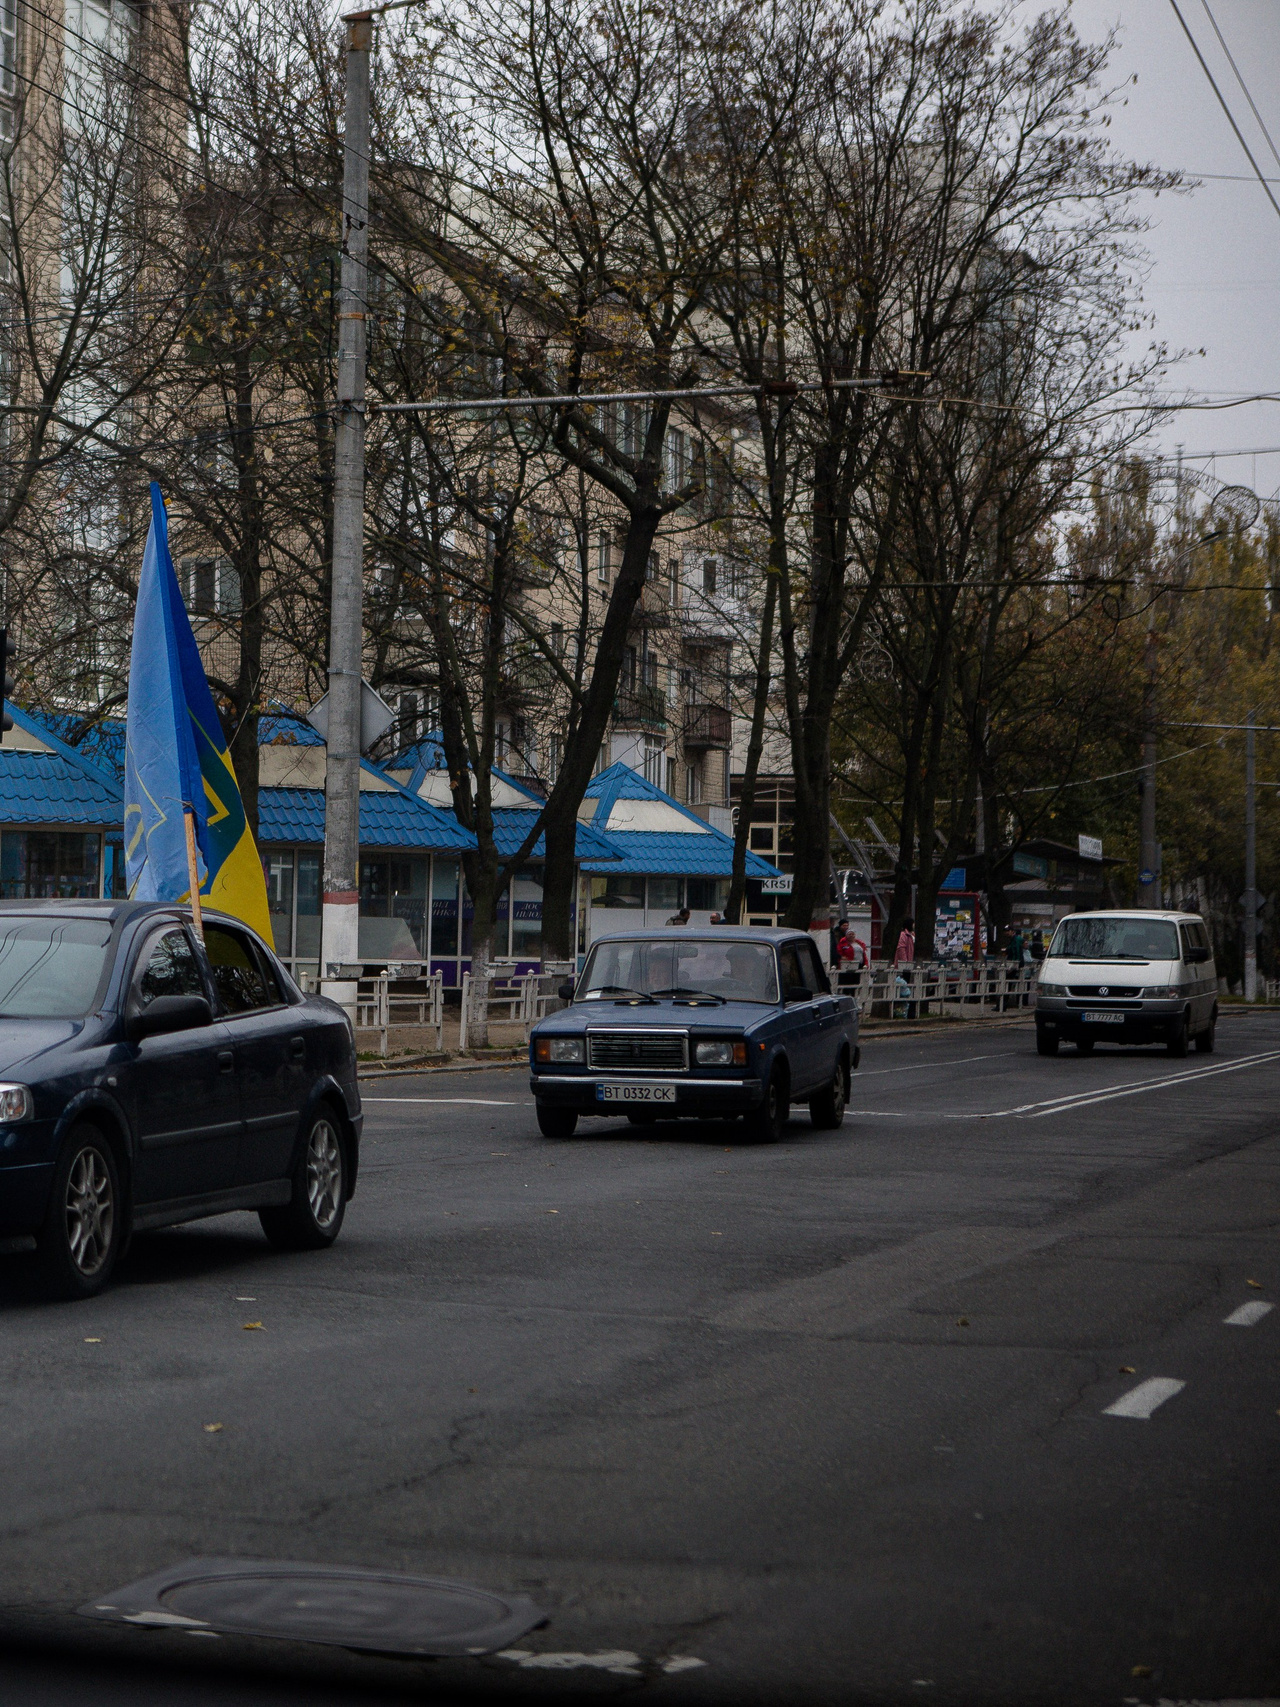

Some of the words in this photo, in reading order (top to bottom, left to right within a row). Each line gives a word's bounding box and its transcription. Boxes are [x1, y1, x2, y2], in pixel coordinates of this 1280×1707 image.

[604, 1086, 620, 1100] BT
[623, 1086, 651, 1101] 0332
[654, 1087, 671, 1101] CK
